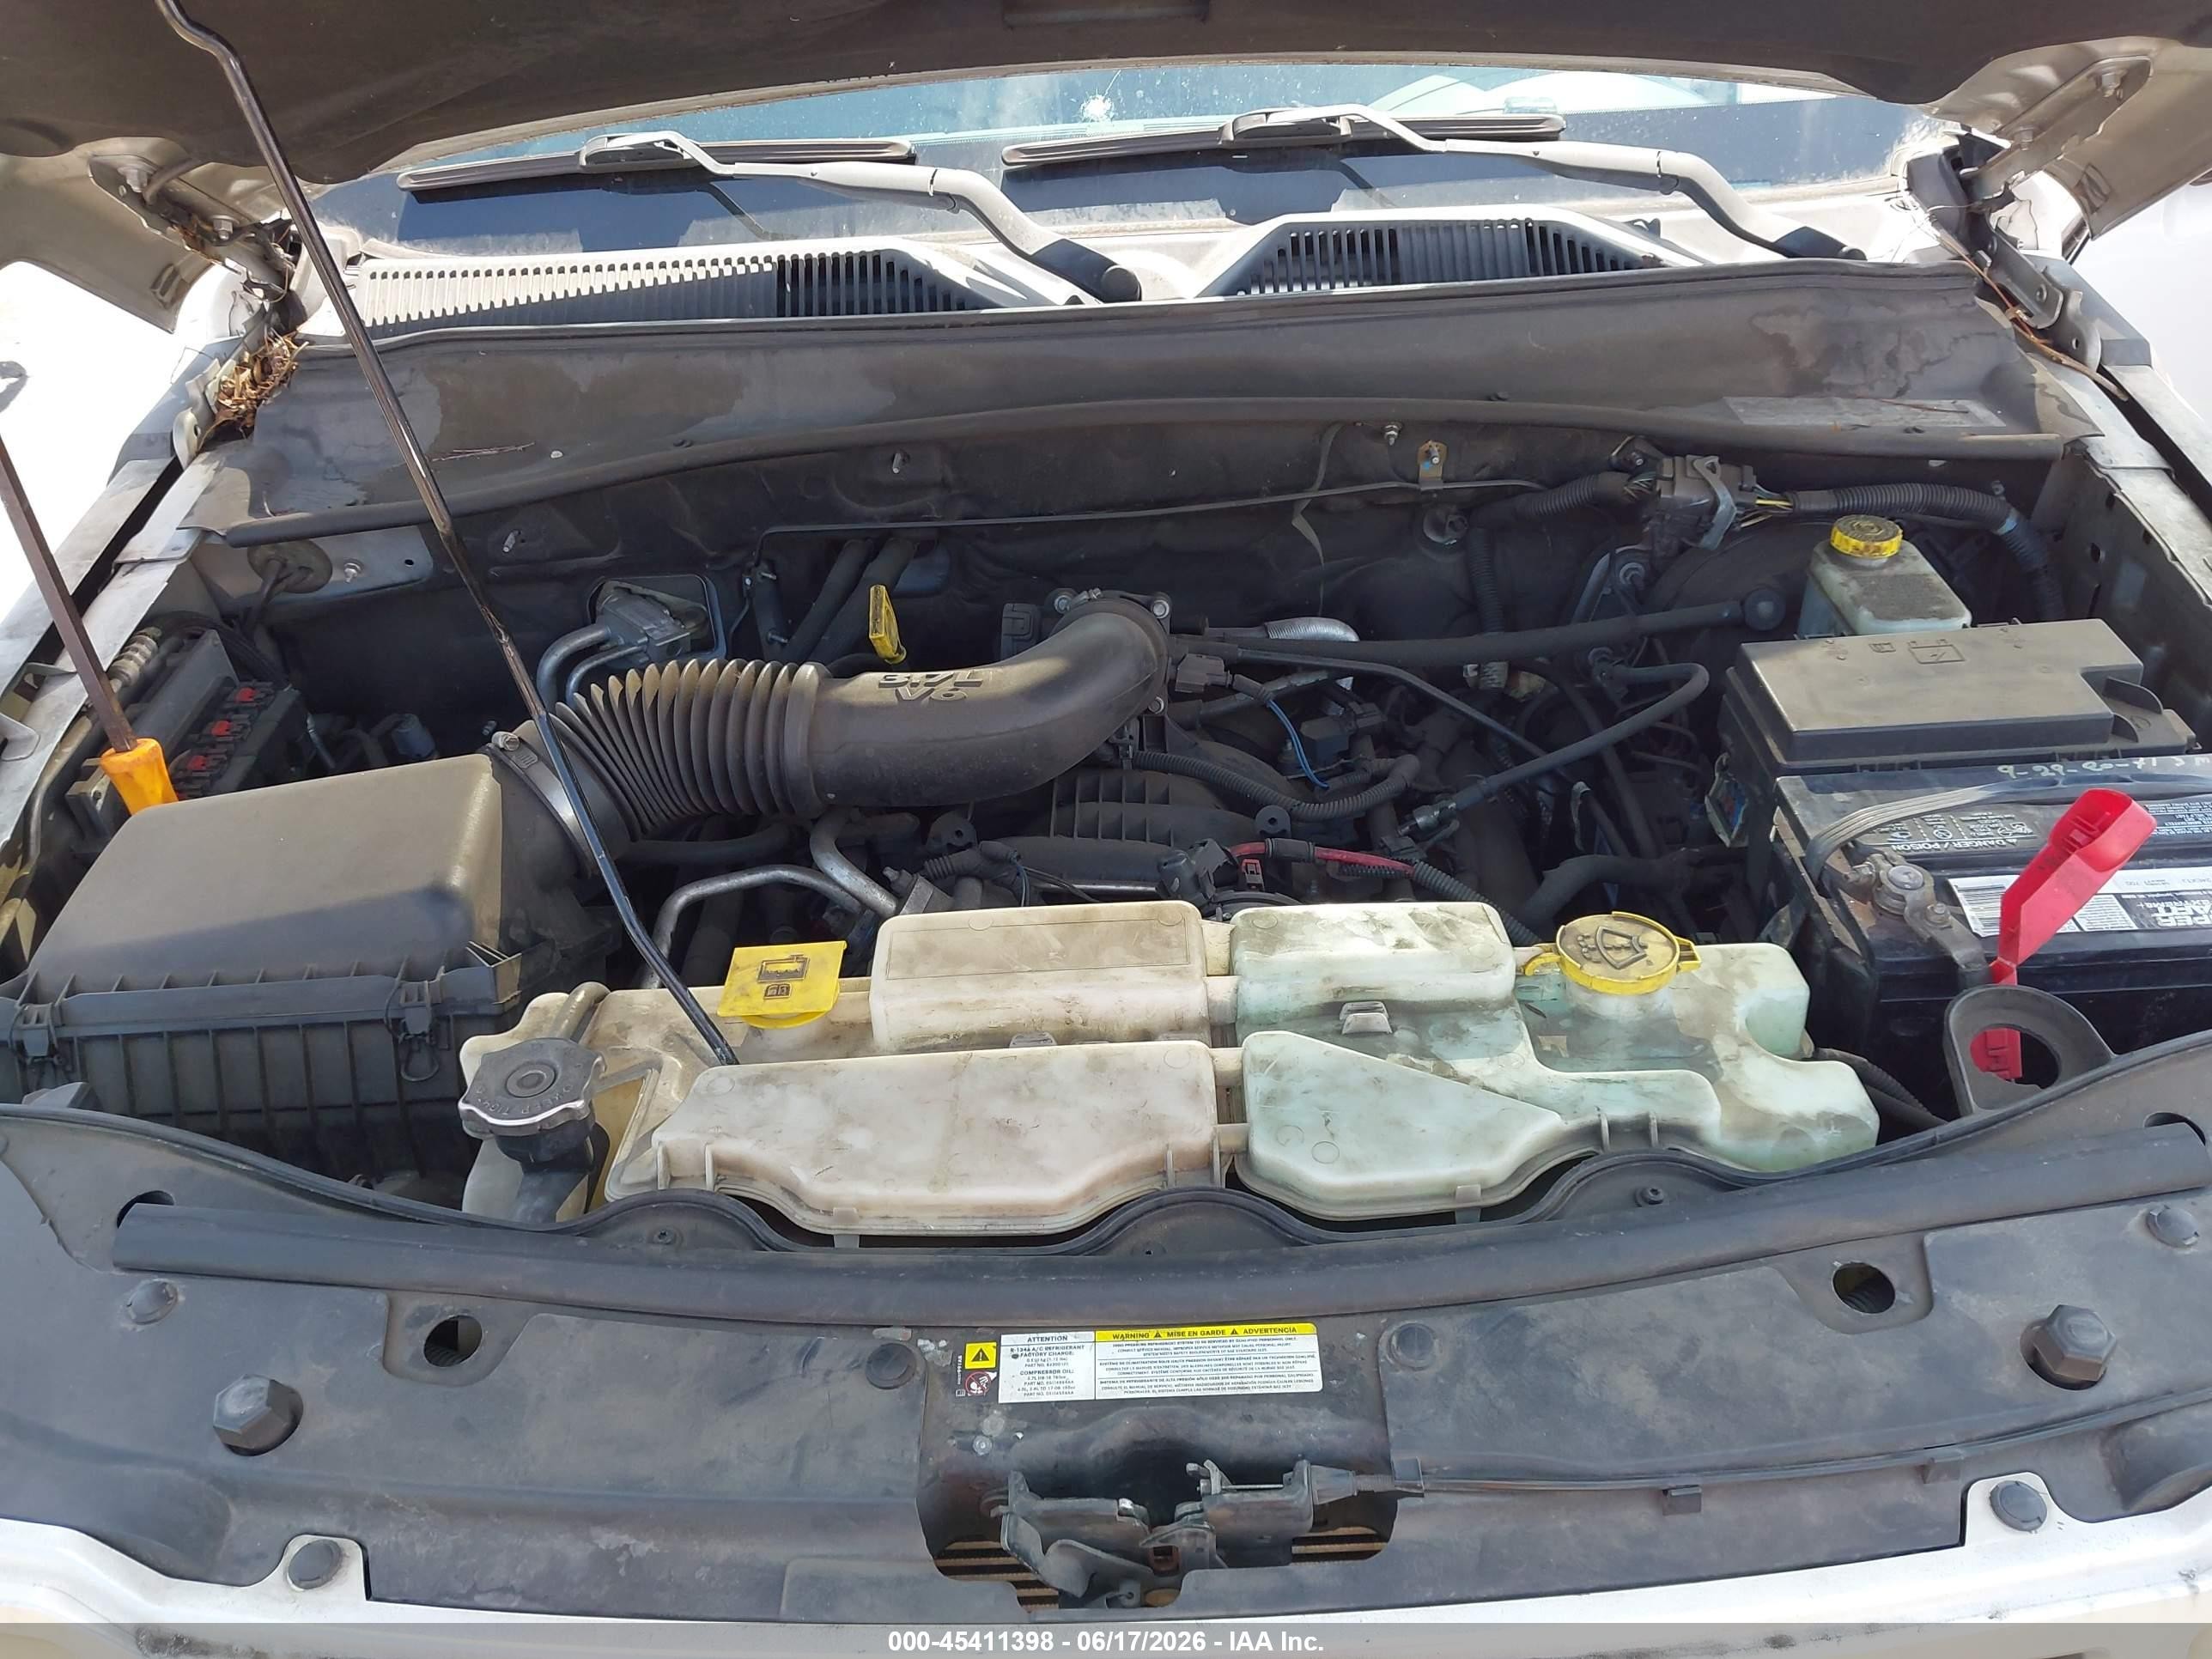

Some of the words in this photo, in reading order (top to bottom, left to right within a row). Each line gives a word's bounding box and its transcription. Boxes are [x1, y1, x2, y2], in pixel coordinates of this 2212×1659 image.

[878, 669, 983, 689] 3.7L
[894, 686, 969, 702] V6
[1892, 842, 1939, 852] POISON
[1952, 839, 2007, 849] DANGER
[2151, 906, 2212, 917] ART
[2156, 915, 2212, 927] PER
[1112, 1332, 1150, 1340] WARNING
